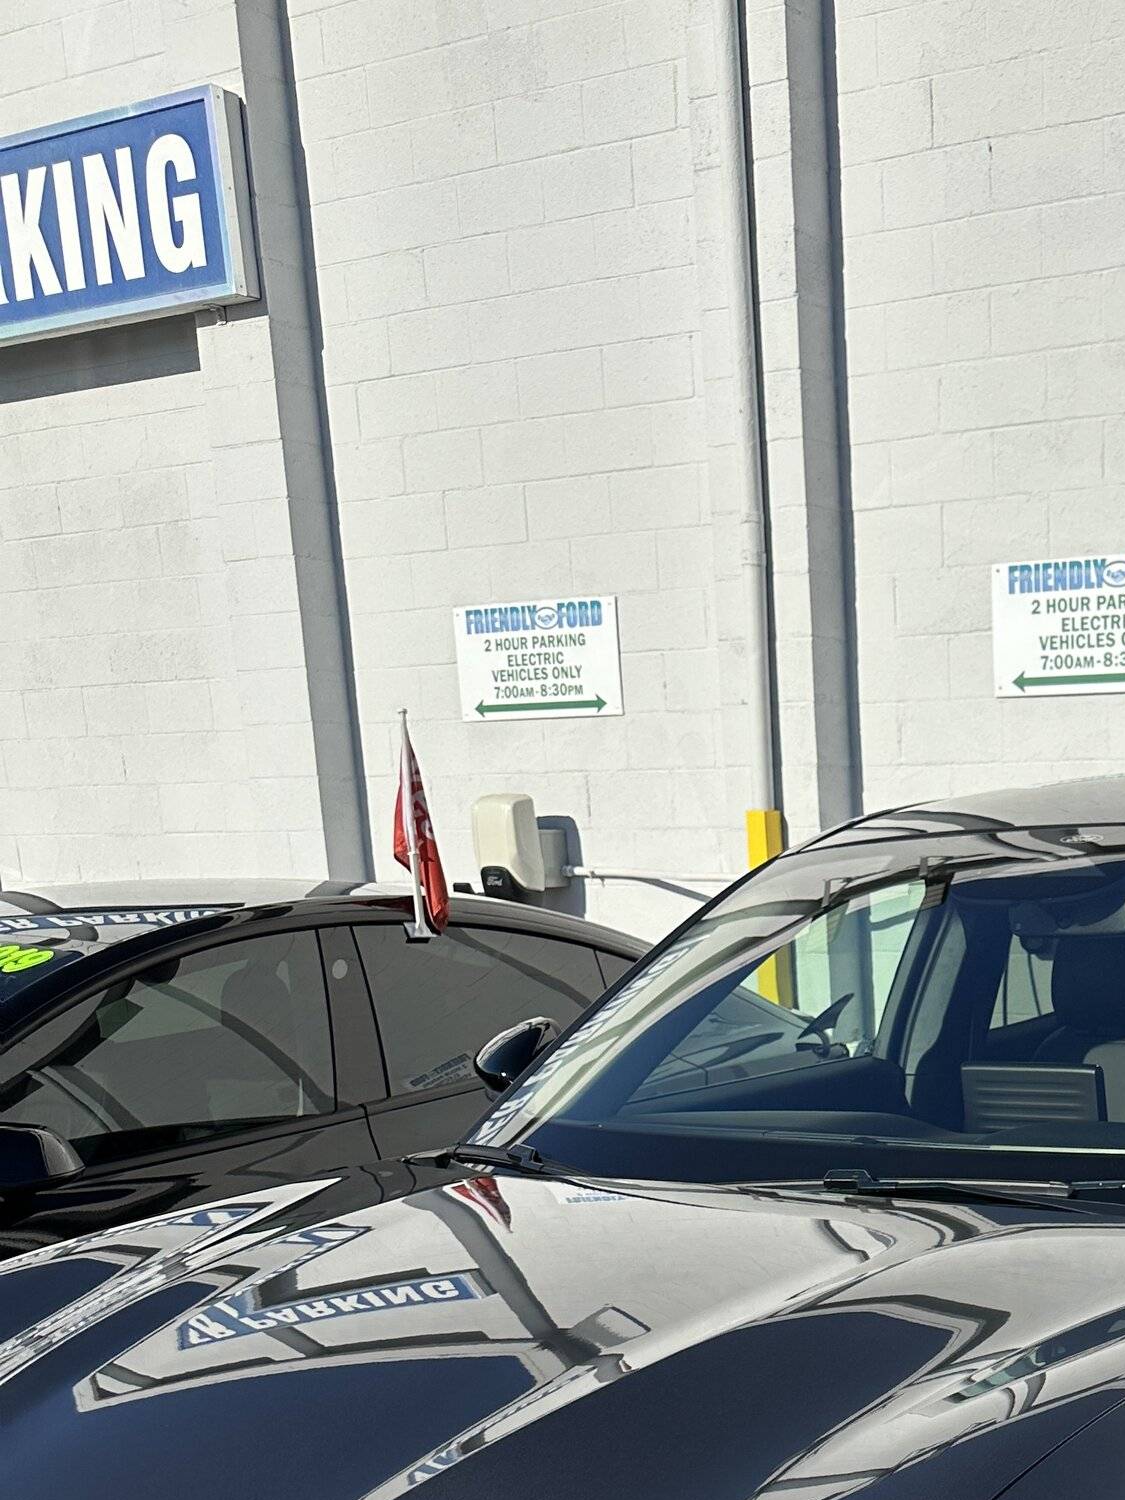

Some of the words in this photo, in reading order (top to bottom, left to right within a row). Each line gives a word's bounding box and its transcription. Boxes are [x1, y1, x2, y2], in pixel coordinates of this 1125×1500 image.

[0, 133, 207, 301] KING
[1008, 558, 1107, 595] FRIENDLY
[1031, 600, 1041, 615] 2
[1046, 596, 1091, 614] HOUR
[465, 604, 537, 635] FRIENDLY
[556, 600, 603, 629] FORD
[484, 639, 492, 652] 2
[495, 636, 528, 651] HOUR
[532, 633, 586, 650] PARKING
[1039, 632, 1116, 651] VEHICLES
[507, 652, 565, 667] ELECTRIC
[491, 667, 549, 682] VEHICLES
[552, 665, 582, 680] ONLY
